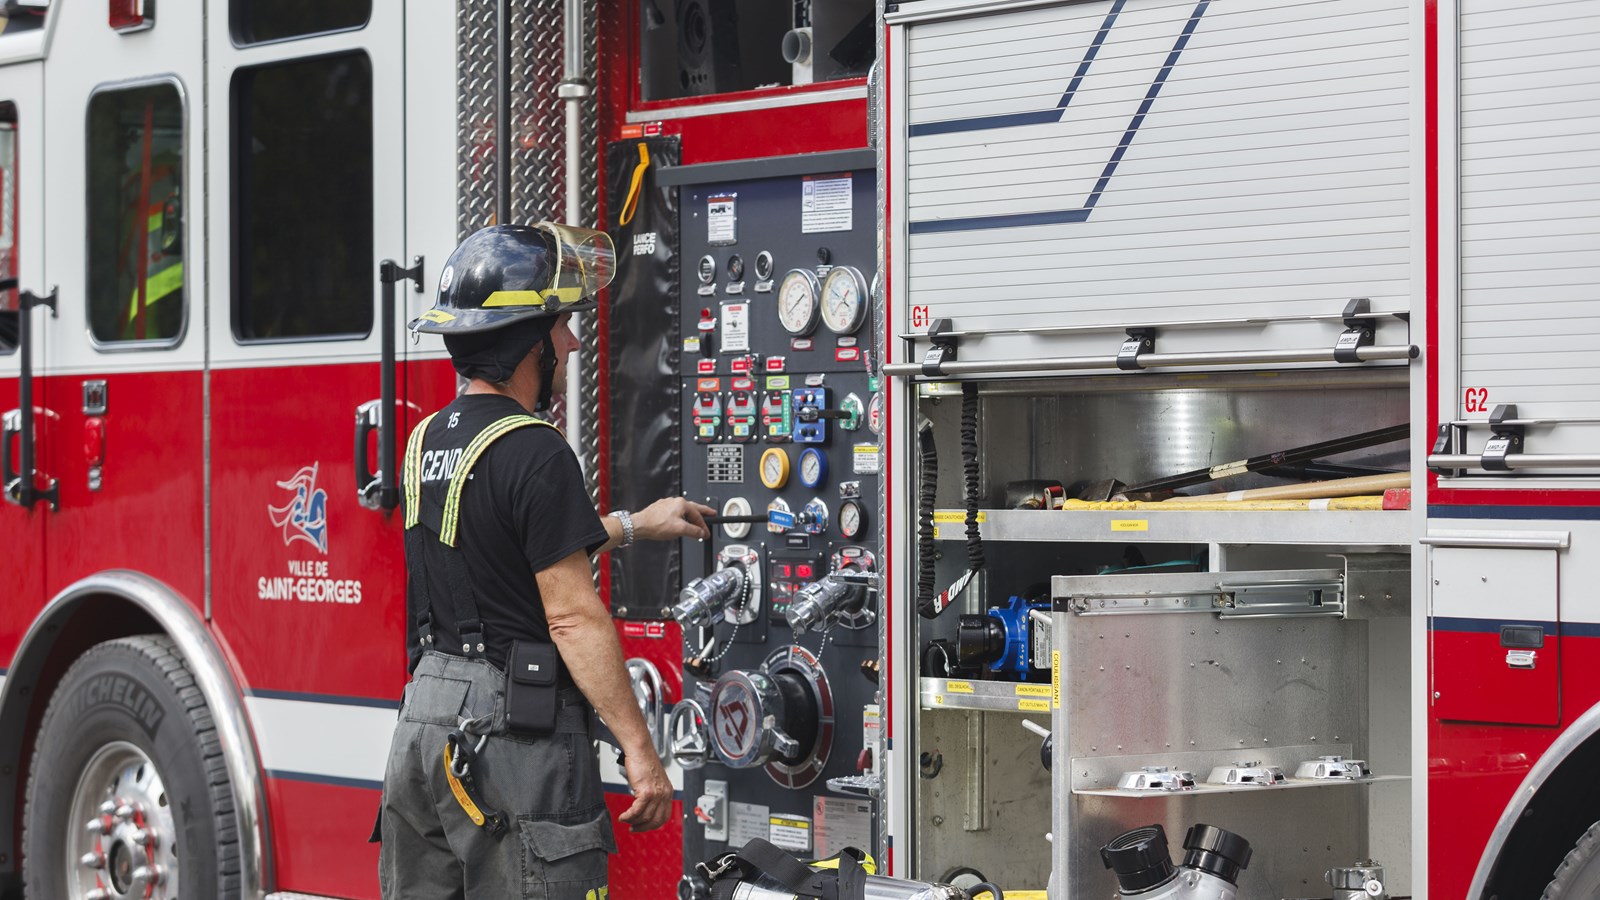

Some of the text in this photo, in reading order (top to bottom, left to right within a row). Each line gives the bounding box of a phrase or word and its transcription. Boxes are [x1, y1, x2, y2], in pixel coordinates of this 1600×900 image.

[633, 232, 656, 245] LANCE
[633, 243, 655, 256] PERFO
[912, 305, 930, 328] G1
[1464, 387, 1489, 413] G2
[447, 412, 461, 429] 15
[405, 448, 474, 484] CEND
[288, 560, 329, 578] VILLE DE
[257, 576, 362, 604] SAINT-GEORGES
[61, 674, 164, 728] MICHELIN
